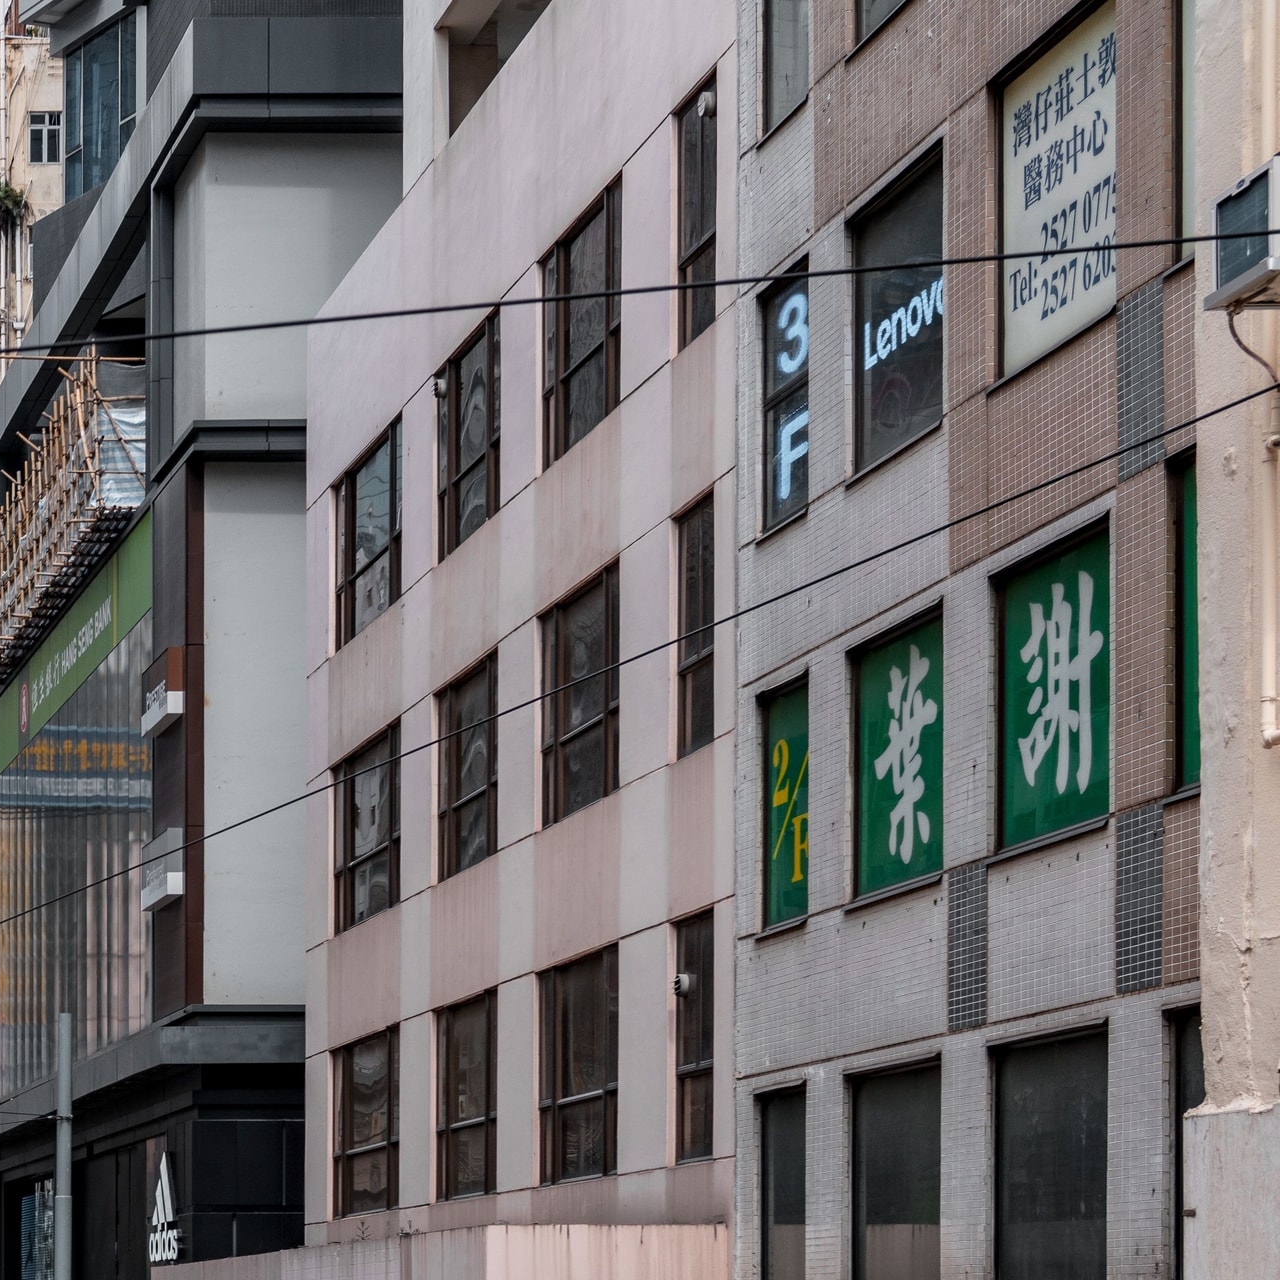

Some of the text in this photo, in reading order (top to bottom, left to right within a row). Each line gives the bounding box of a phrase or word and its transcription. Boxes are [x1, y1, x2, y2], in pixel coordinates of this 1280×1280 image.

[1023, 111, 1108, 212] 醫務中心
[1040, 199, 1078, 265] 2527
[1009, 257, 1078, 321] Tel: 2527
[61, 595, 112, 676] HANG SENG BANK
[149, 1222, 178, 1262] adidas
